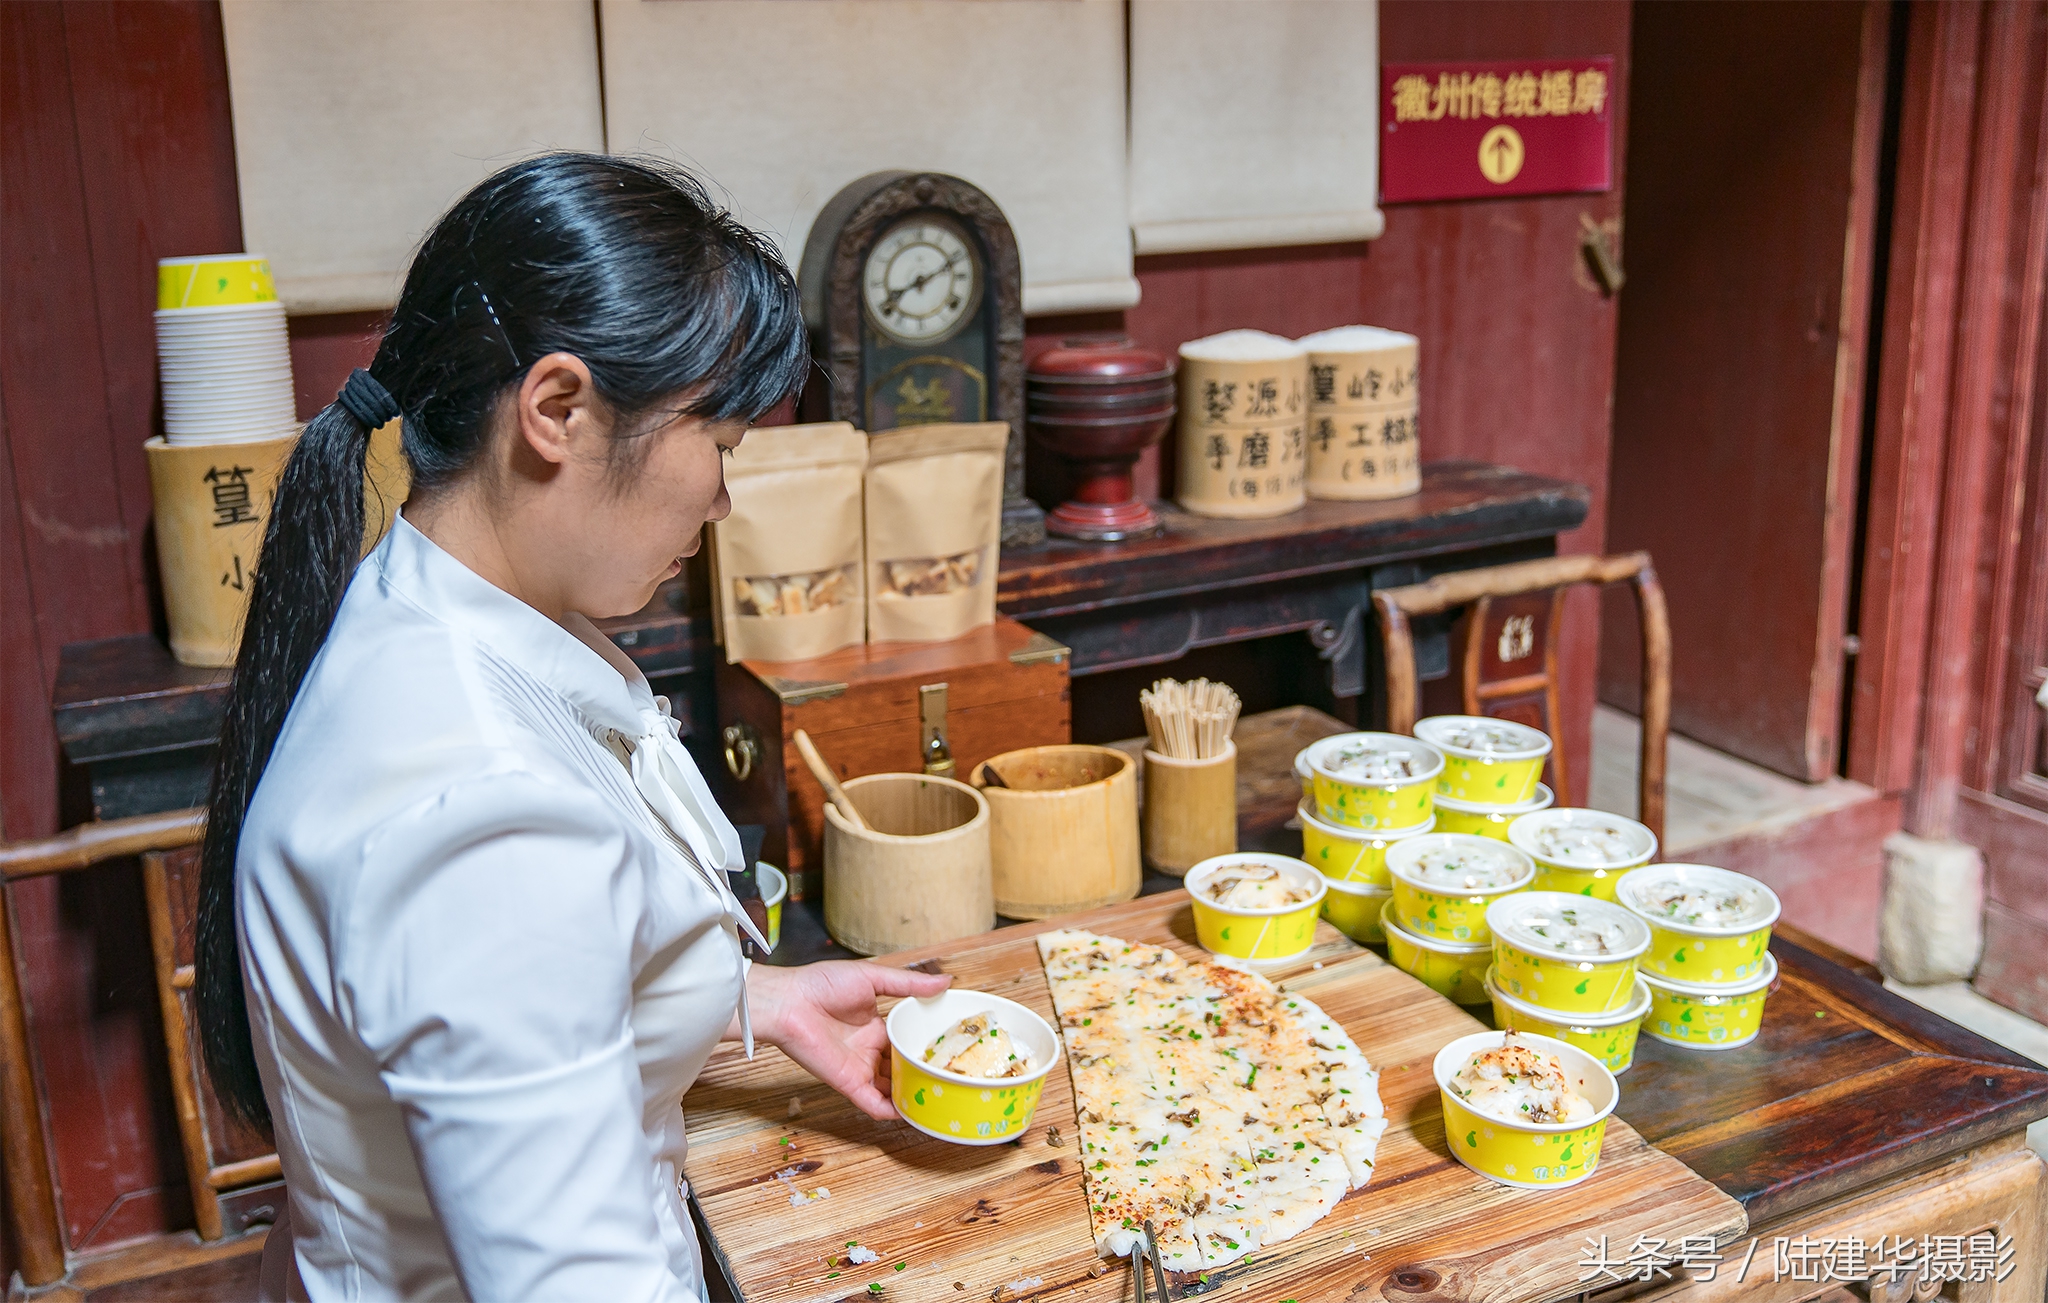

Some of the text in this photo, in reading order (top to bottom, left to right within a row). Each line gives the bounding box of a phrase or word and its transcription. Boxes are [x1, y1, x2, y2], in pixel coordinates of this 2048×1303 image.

[1392, 68, 1608, 122] 徽州传统婚房
[203, 464, 277, 528] 篁
